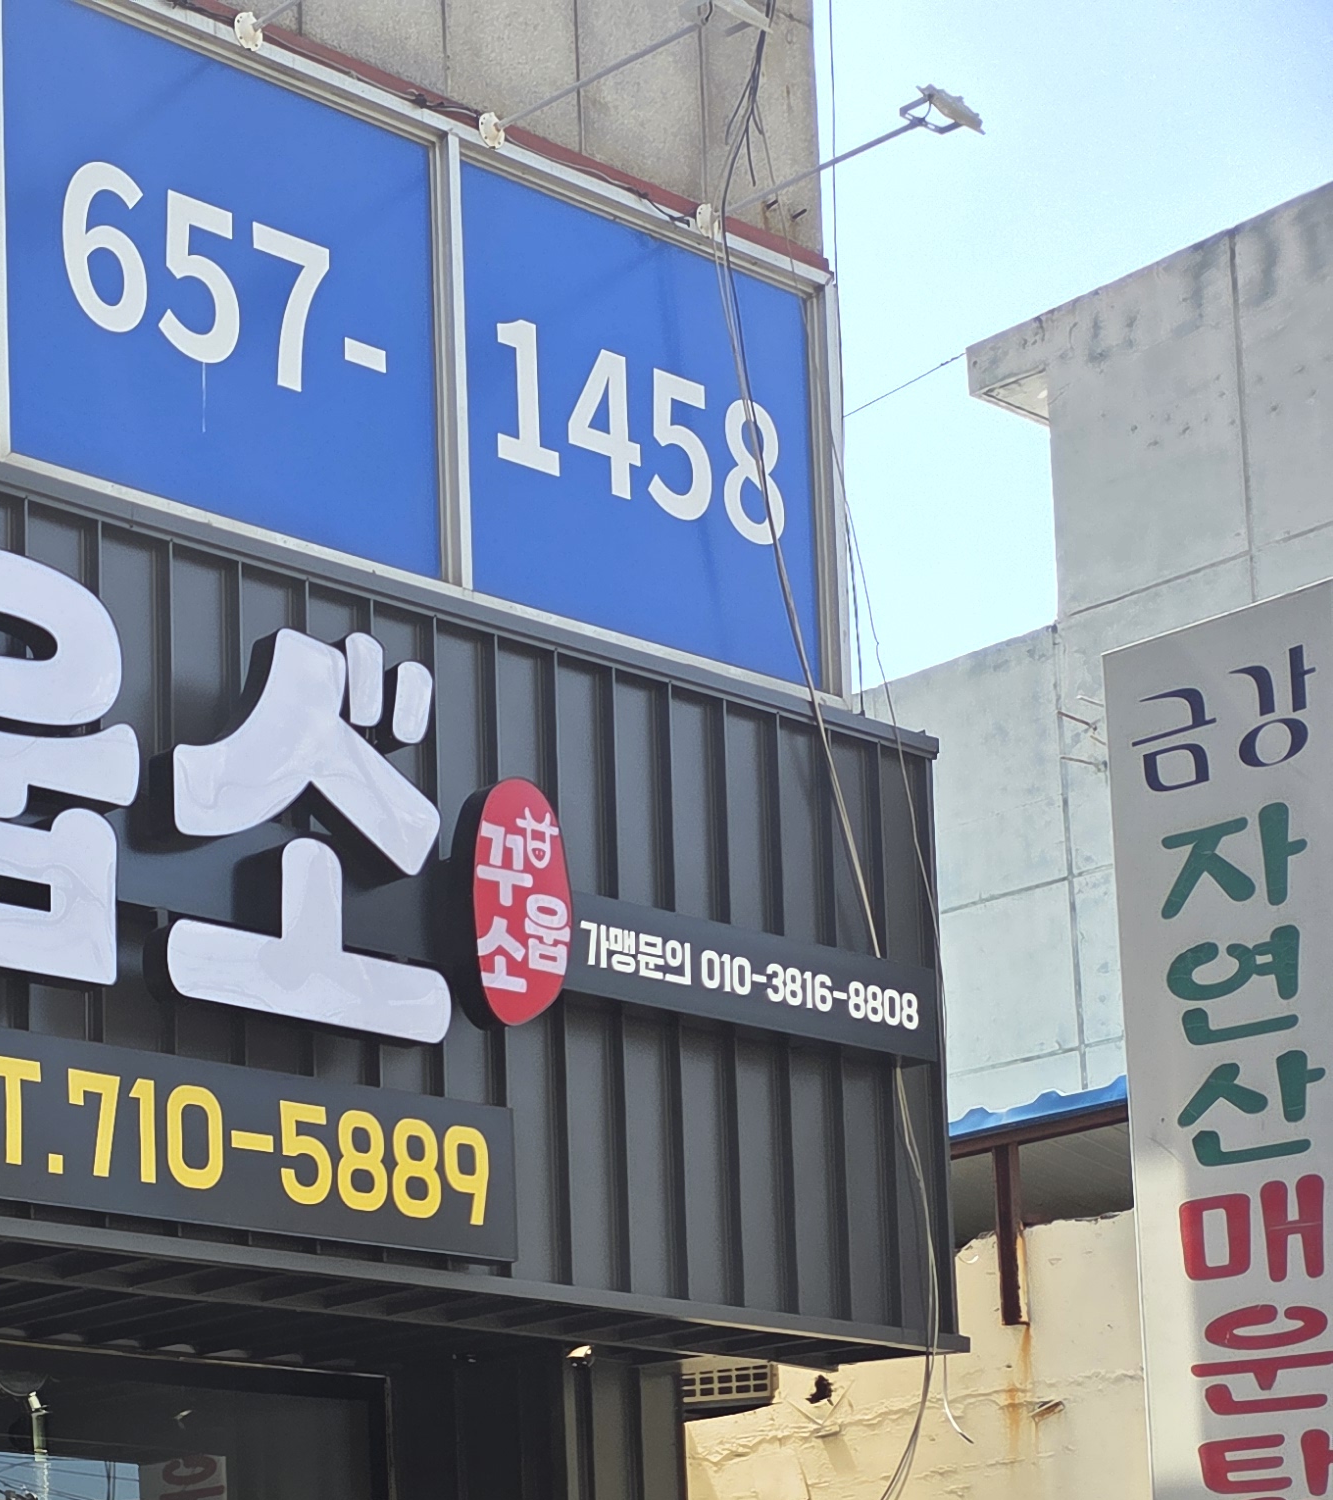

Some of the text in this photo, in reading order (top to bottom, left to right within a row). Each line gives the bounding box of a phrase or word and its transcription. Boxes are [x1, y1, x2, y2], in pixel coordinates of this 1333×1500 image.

[63, 161, 385, 391] 657-
[494, 319, 786, 545] 1458
[1133, 644, 1319, 793] 금강
[580, 920, 920, 1030] 가맹문의 010-3816-8808
[1161, 803, 1327, 1167] 자연산
